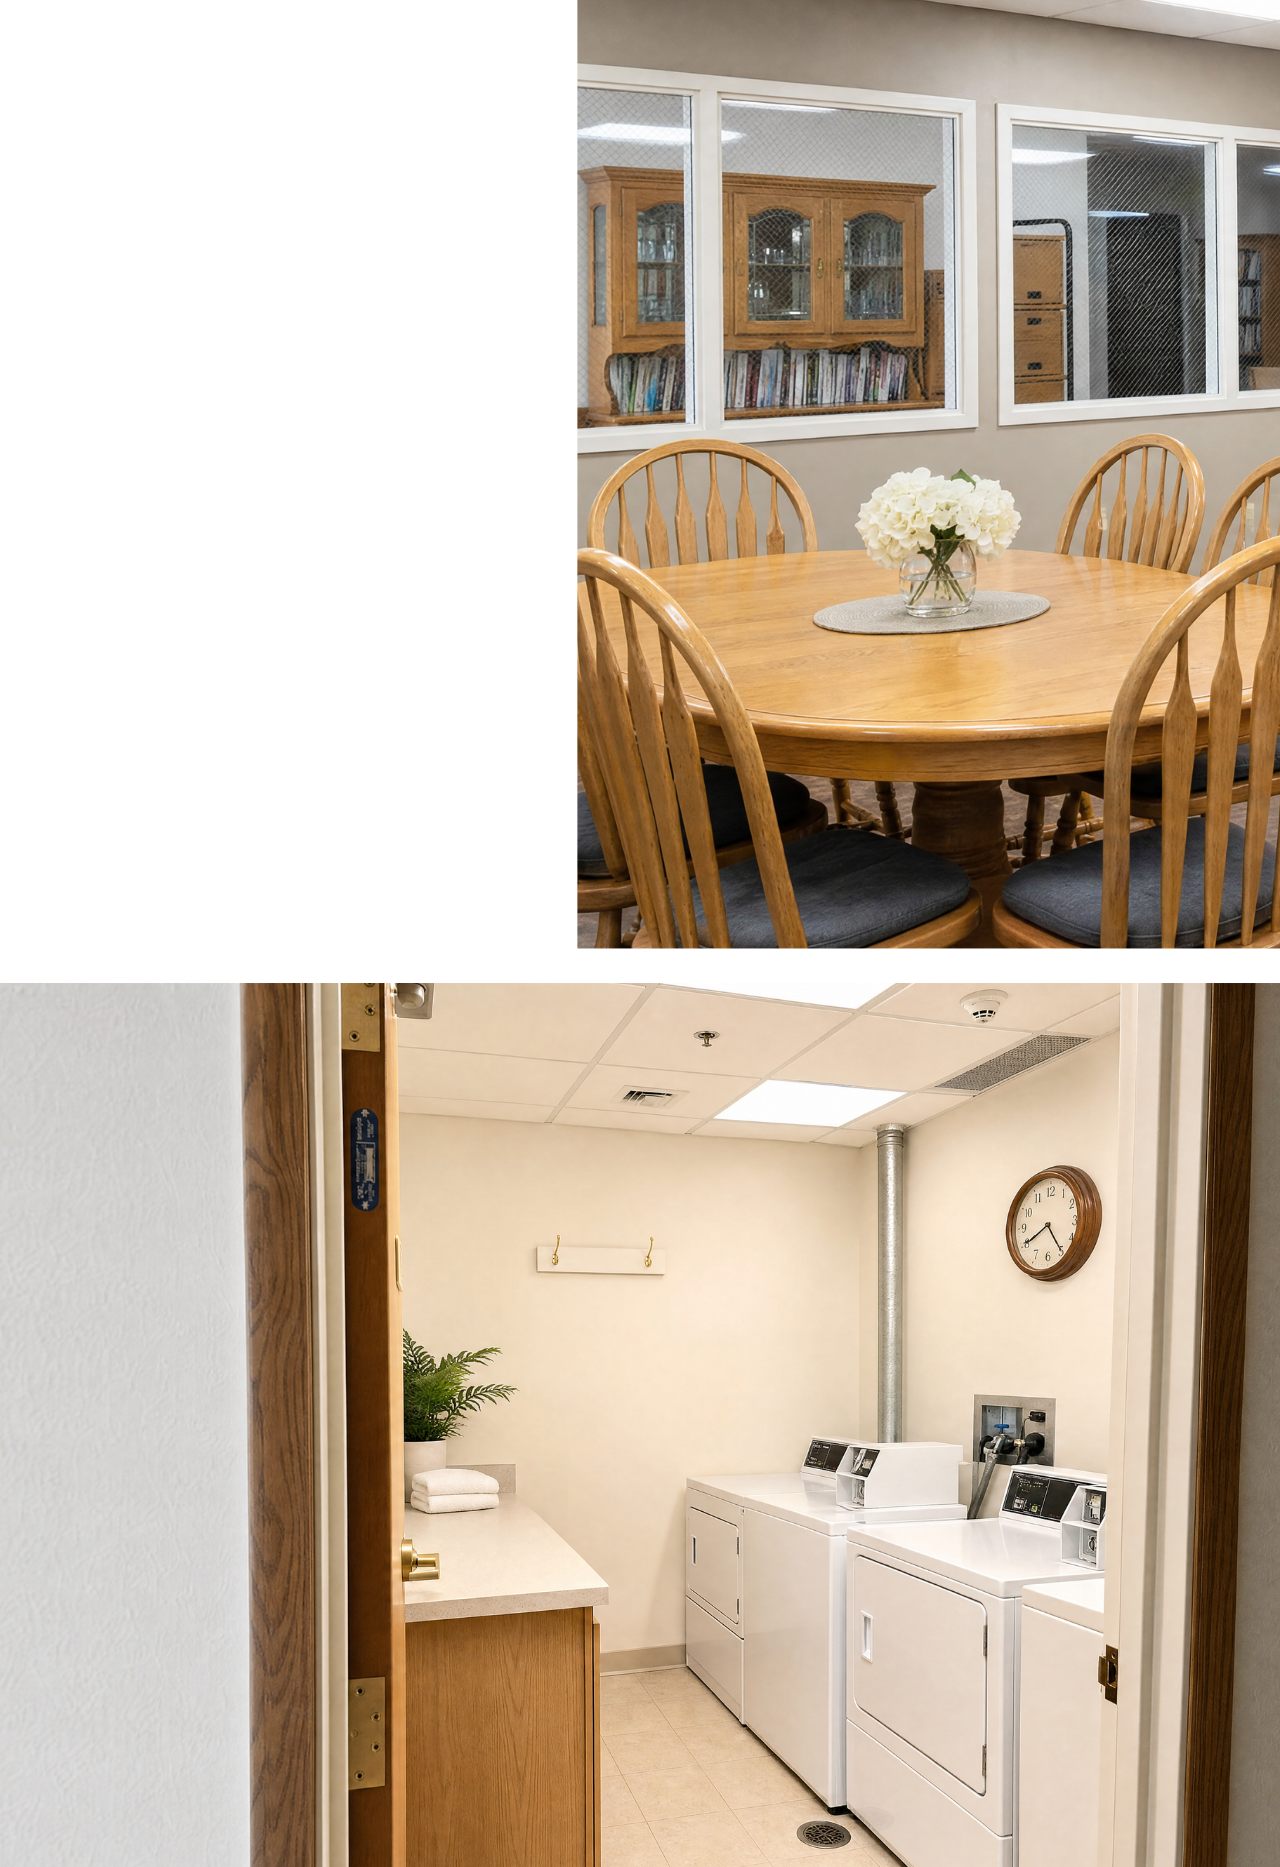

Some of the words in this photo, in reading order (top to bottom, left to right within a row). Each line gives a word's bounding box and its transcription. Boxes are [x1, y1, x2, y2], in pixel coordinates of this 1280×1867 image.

[1046, 1186, 1056, 1198] 12
[1062, 1188, 1065, 1199] 1
[1034, 1193, 1042, 1204] 11
[1069, 1198, 1075, 1210] 2
[1025, 1207, 1033, 1218] 10
[1071, 1214, 1078, 1226] 3
[1021, 1223, 1027, 1234] 9
[1068, 1232, 1074, 1241] 4
[1033, 1249, 1039, 1260] 7
[1045, 1251, 1051, 1262] 6
[1058, 1245, 1065, 1257] 5
